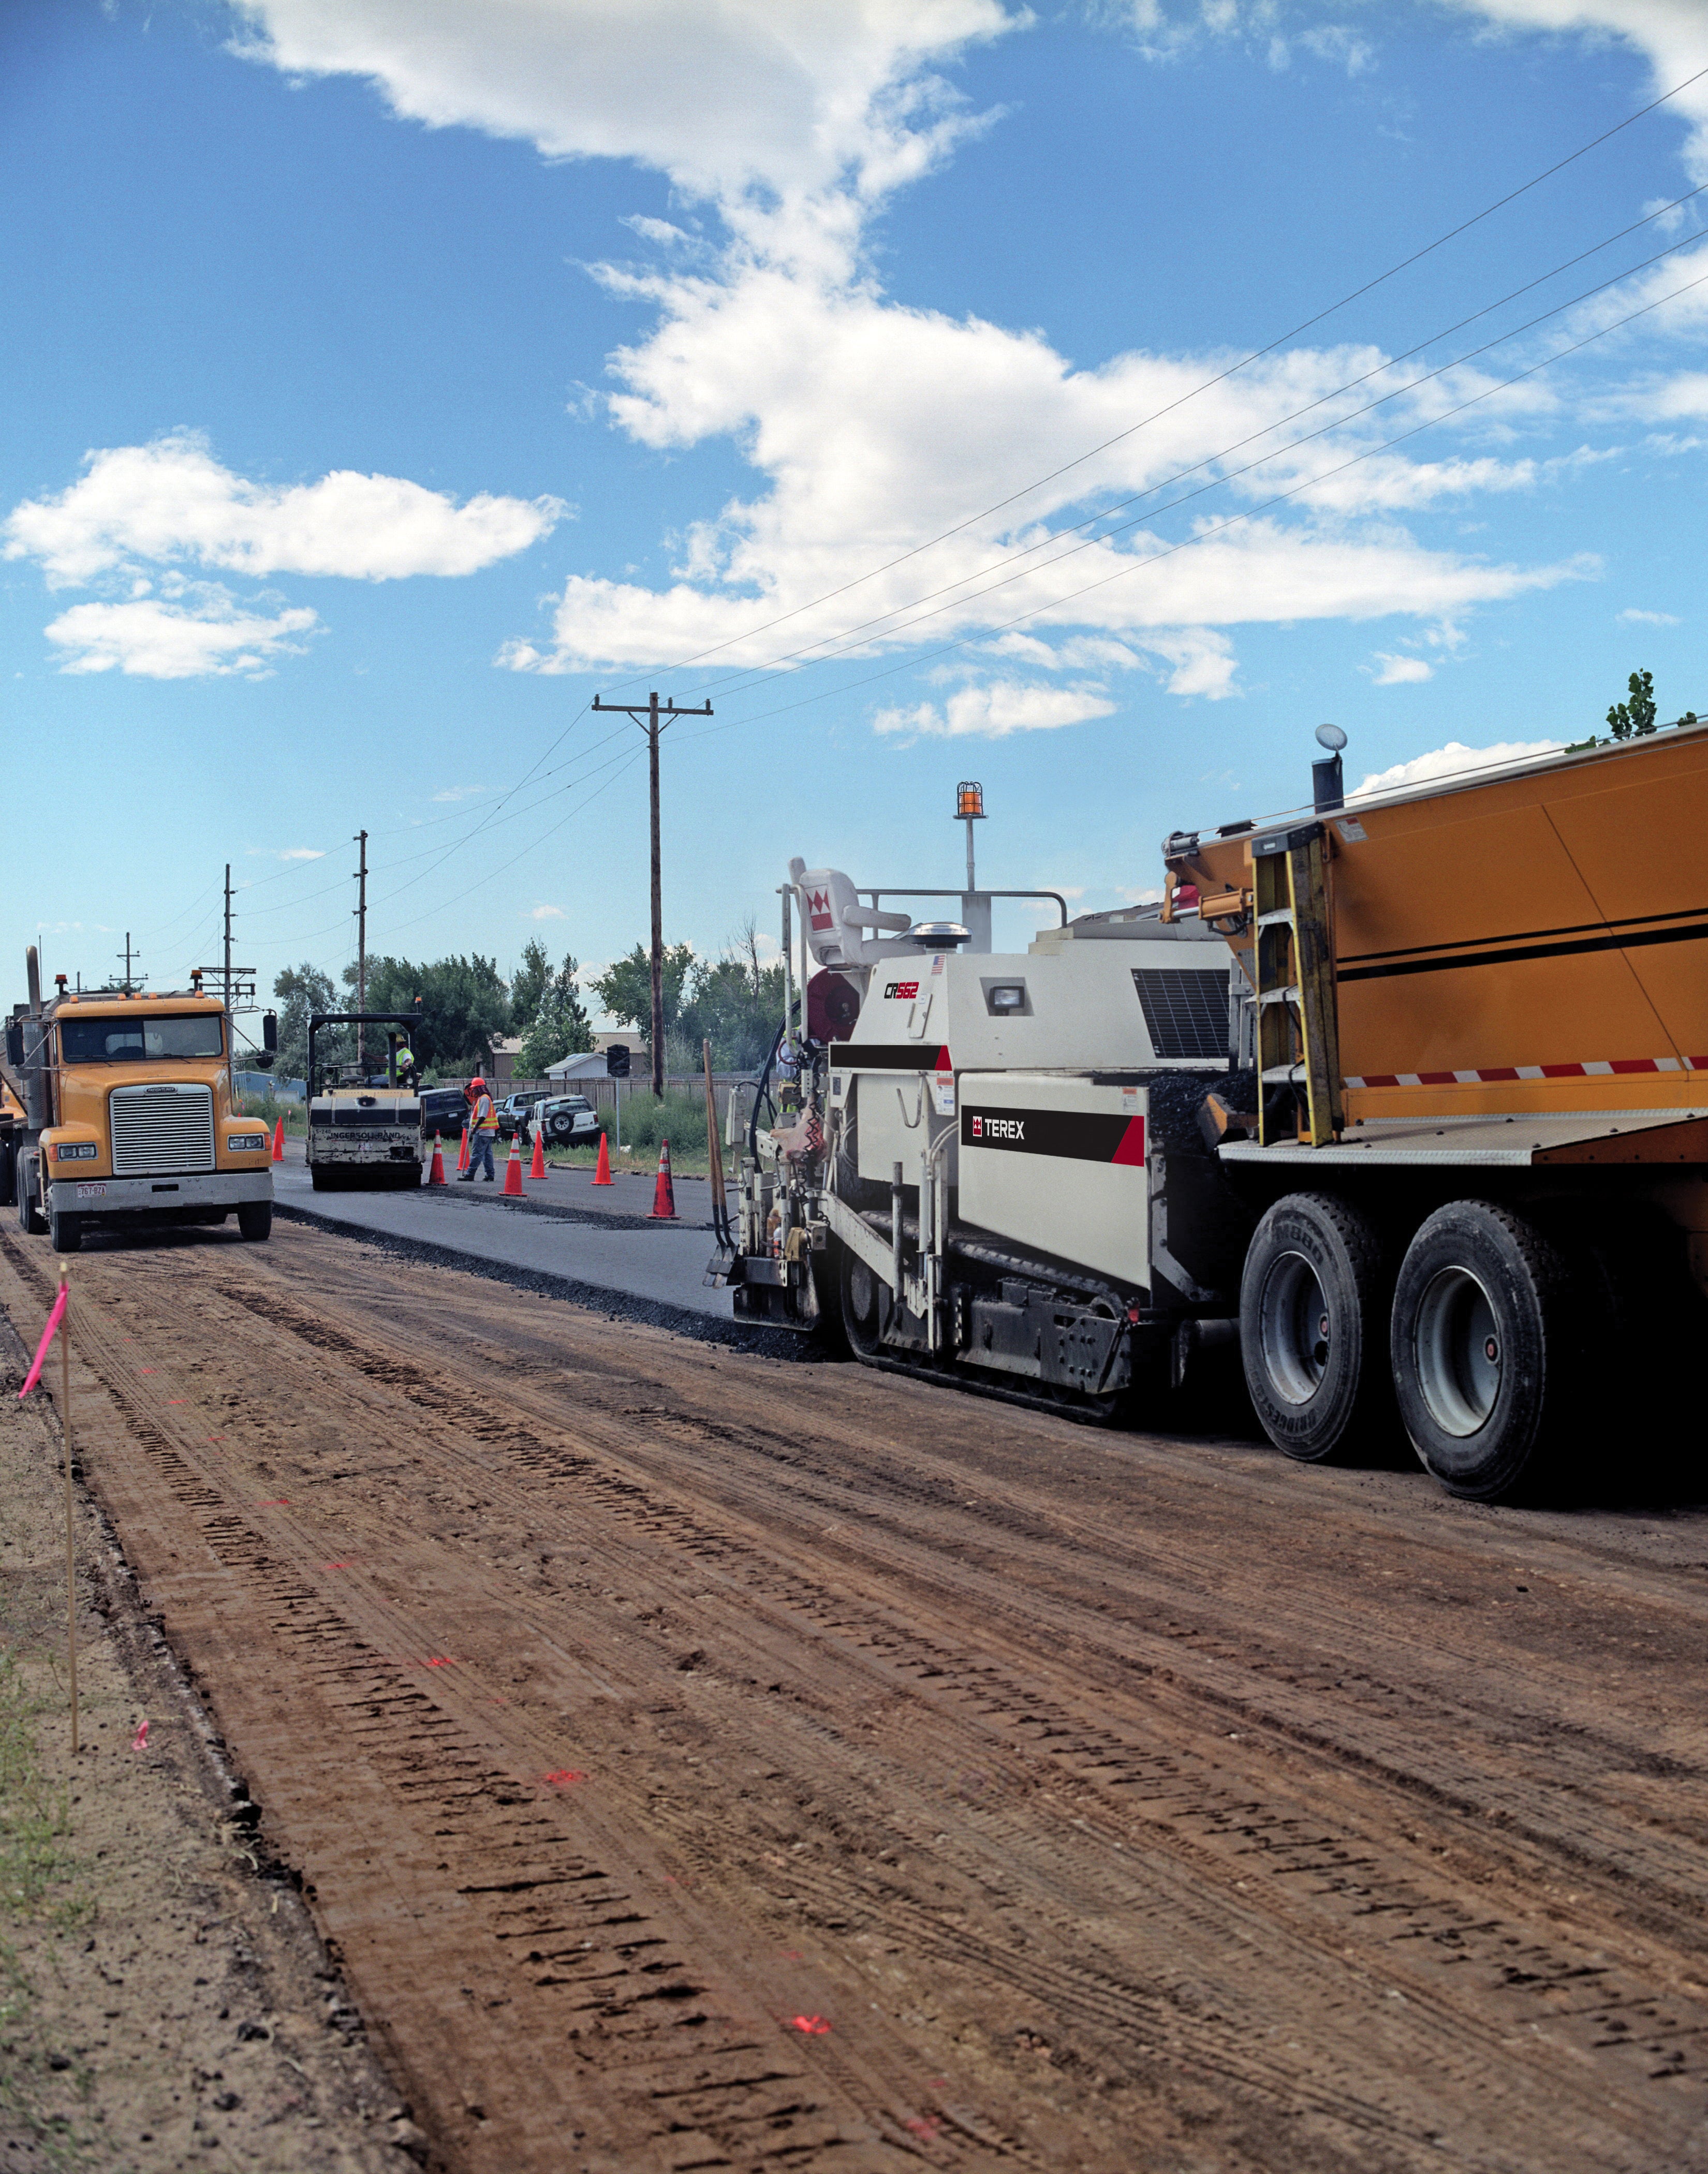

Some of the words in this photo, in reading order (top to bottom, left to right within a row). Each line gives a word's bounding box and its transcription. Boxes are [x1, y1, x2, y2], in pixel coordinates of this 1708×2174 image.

[884, 982, 919, 999] CR562
[466, 1088, 478, 1098] SLO
[984, 1119, 1025, 1139] TEREX
